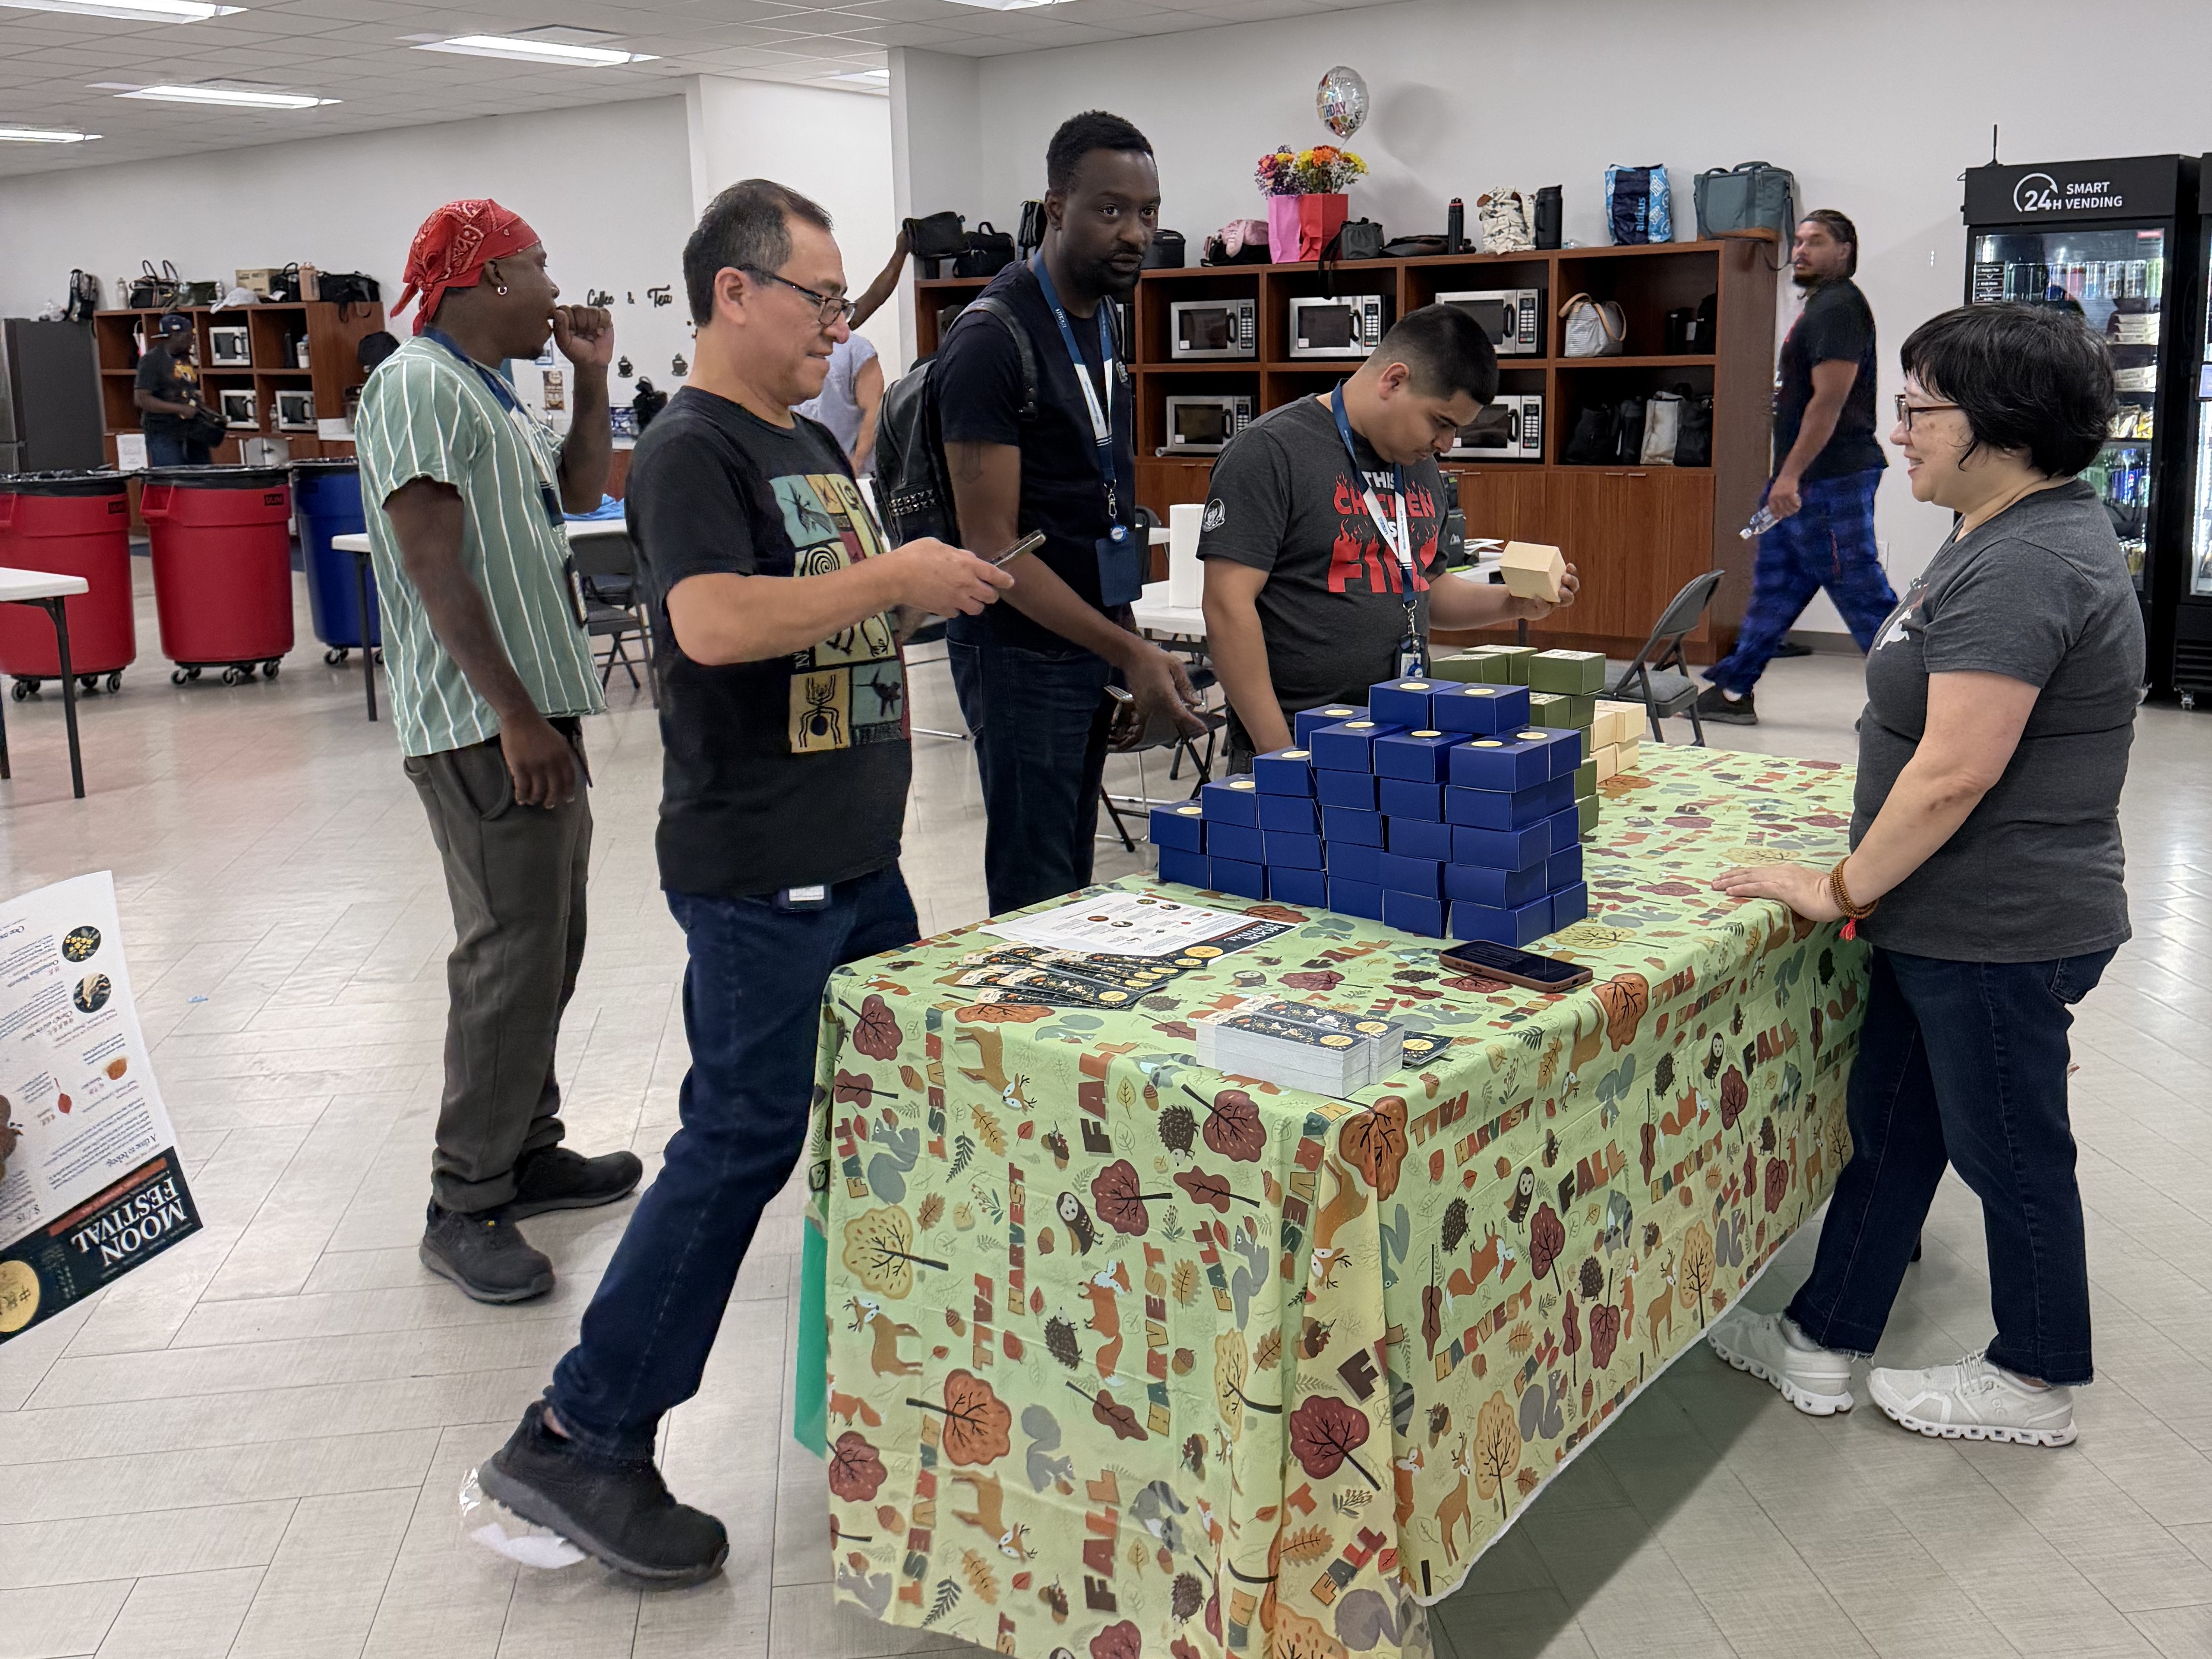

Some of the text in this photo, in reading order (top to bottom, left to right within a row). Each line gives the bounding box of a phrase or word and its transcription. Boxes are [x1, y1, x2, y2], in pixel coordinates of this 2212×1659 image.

[1634, 197, 1646, 231] aldi.us
[2065, 196, 2123, 210] VENDING
[2066, 181, 2110, 195] SMART
[646, 285, 673, 308] Tea
[1743, 1017, 1798, 1081] FALL
[1410, 1089, 1469, 1147] FALL
[1454, 1097, 1535, 1167] HARVEST
[1558, 1139, 1628, 1216] FALL
[70, 1177, 179, 1254] FESTIVAL
[101, 1198, 187, 1267] MOON
[1083, 1468, 1120, 1613] FALL
[1311, 1526, 1387, 1607] FALL
